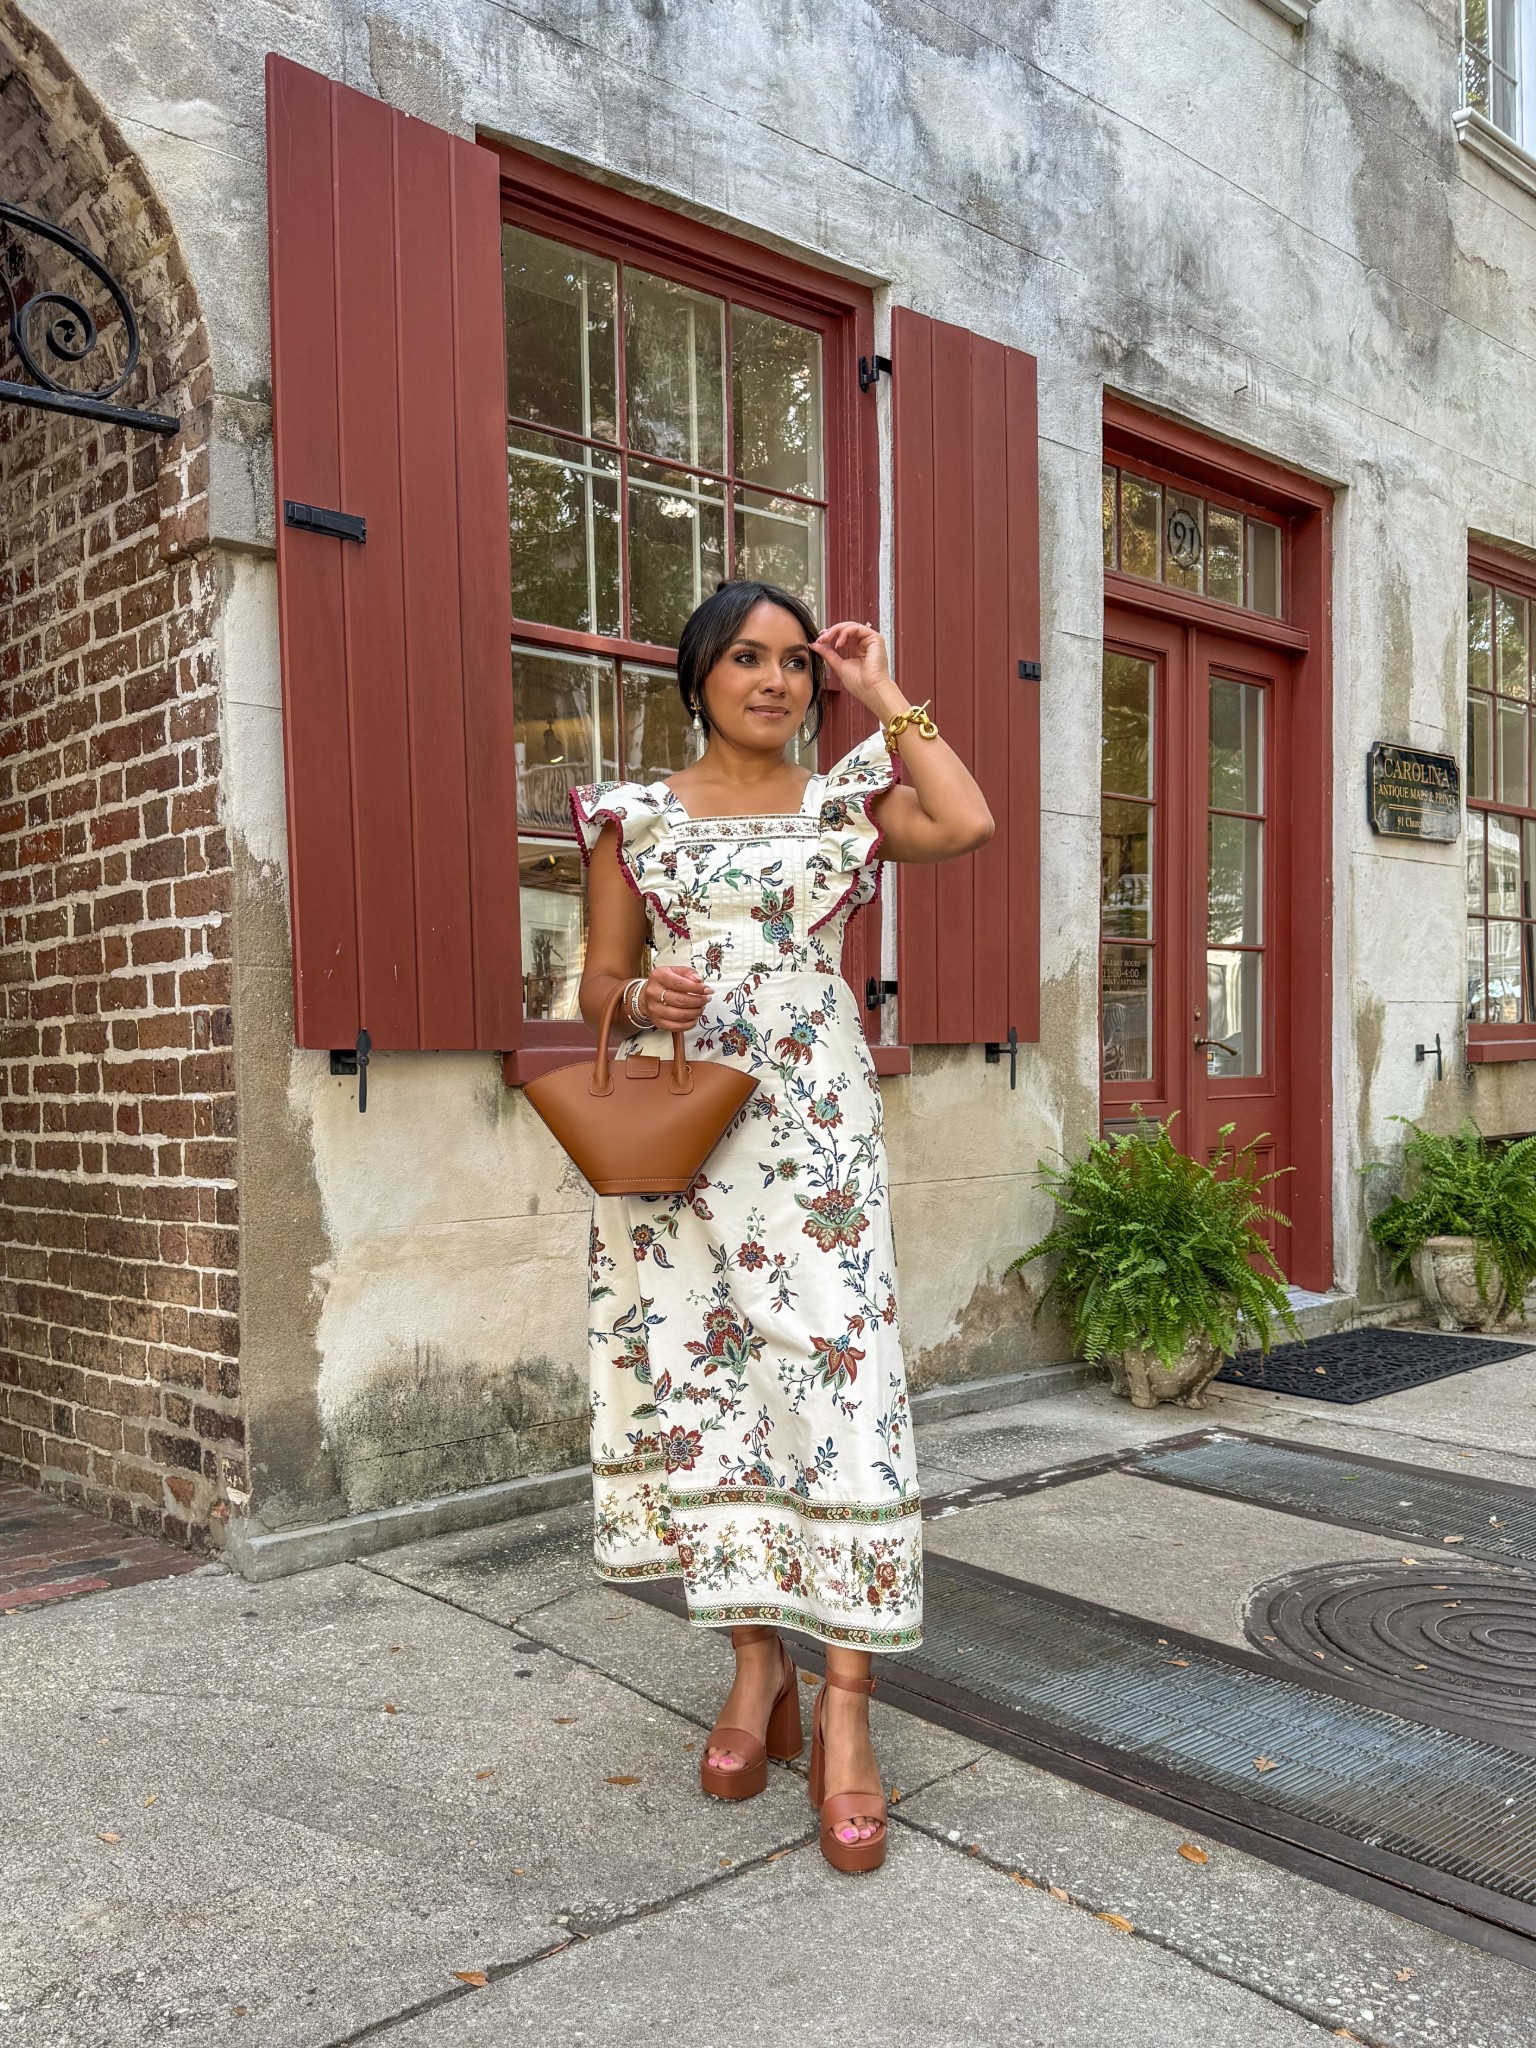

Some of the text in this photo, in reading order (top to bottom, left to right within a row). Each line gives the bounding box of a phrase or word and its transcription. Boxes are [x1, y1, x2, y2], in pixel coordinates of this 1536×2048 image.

[1174, 521, 1195, 559] 91
[1384, 758, 1450, 788] CAROLINA
[1378, 784, 1456, 806] ANTIQUE MAPS & PRINTS
[1397, 816, 1404, 827] 91
